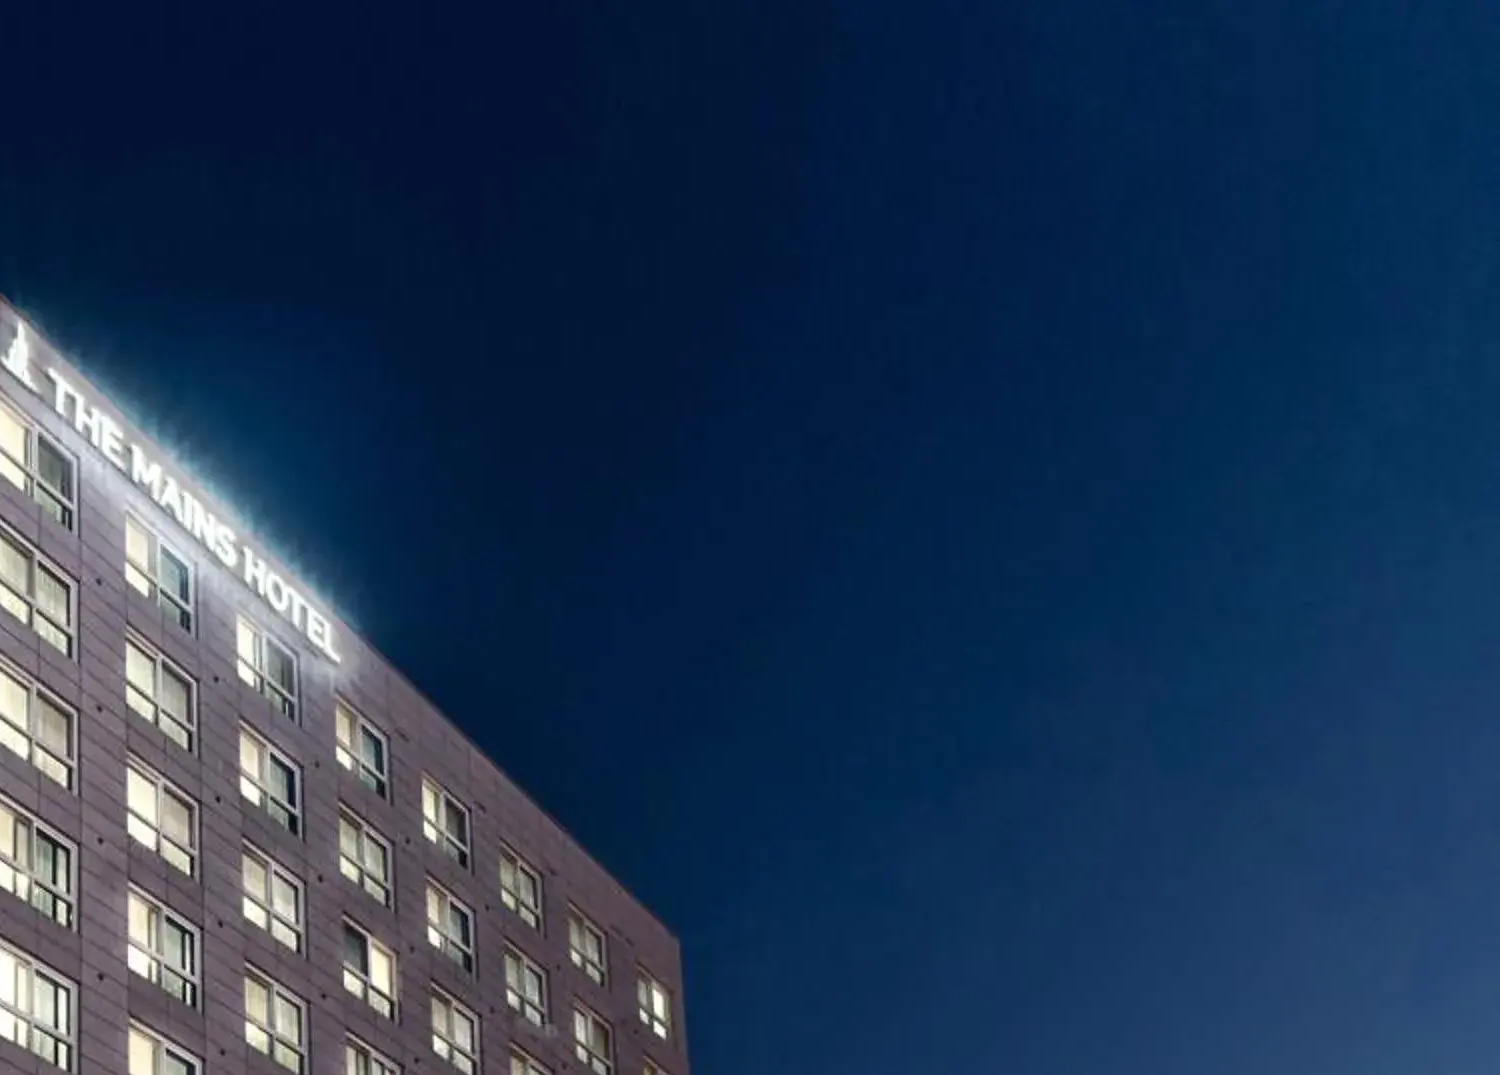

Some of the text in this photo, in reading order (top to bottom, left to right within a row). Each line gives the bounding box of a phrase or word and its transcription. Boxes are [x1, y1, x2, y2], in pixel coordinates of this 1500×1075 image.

[47, 367, 341, 665] THE MAINS HOTEL
